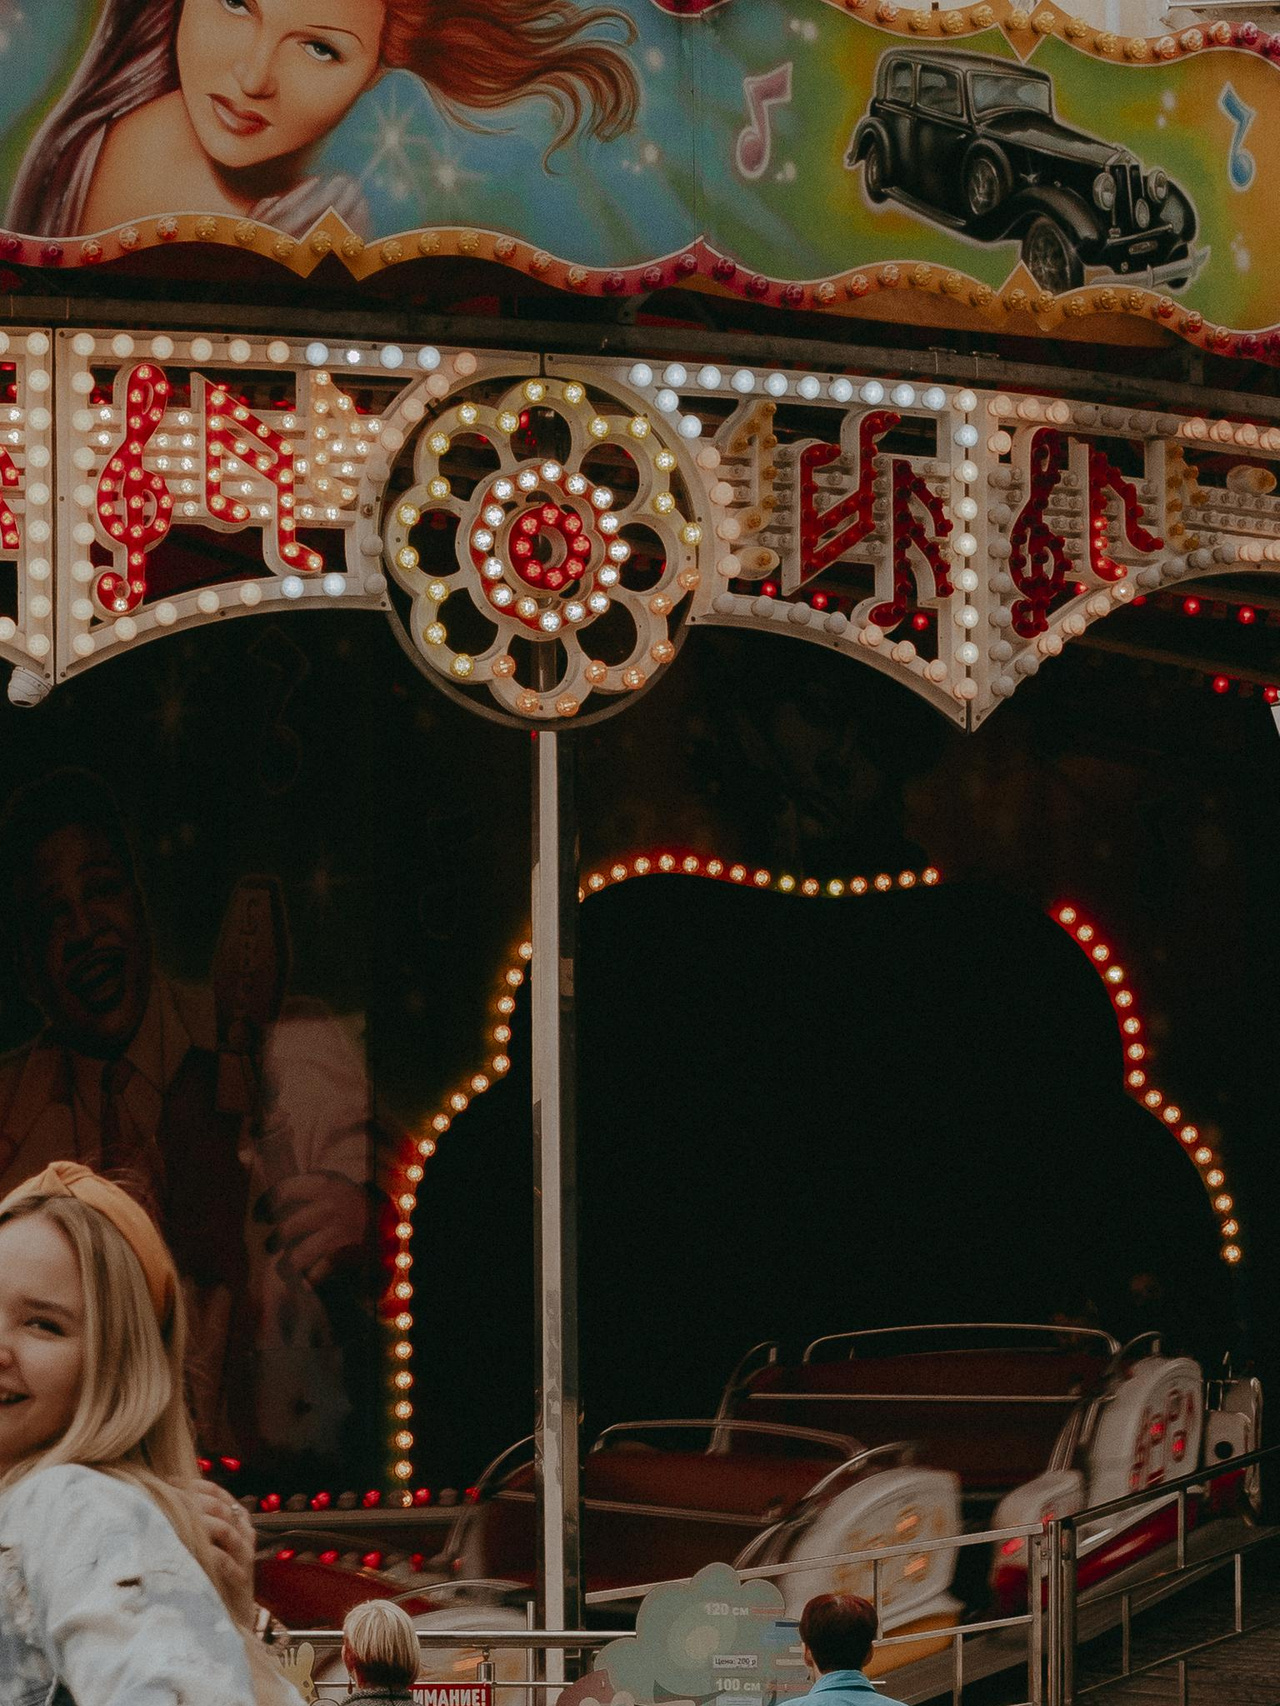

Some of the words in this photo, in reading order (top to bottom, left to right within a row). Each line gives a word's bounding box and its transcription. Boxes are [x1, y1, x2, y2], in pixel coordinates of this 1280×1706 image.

[705, 1602, 729, 1615] 120
[716, 1678, 740, 1691] 100
[411, 1688, 487, 1706] ИМАНИЕ!
